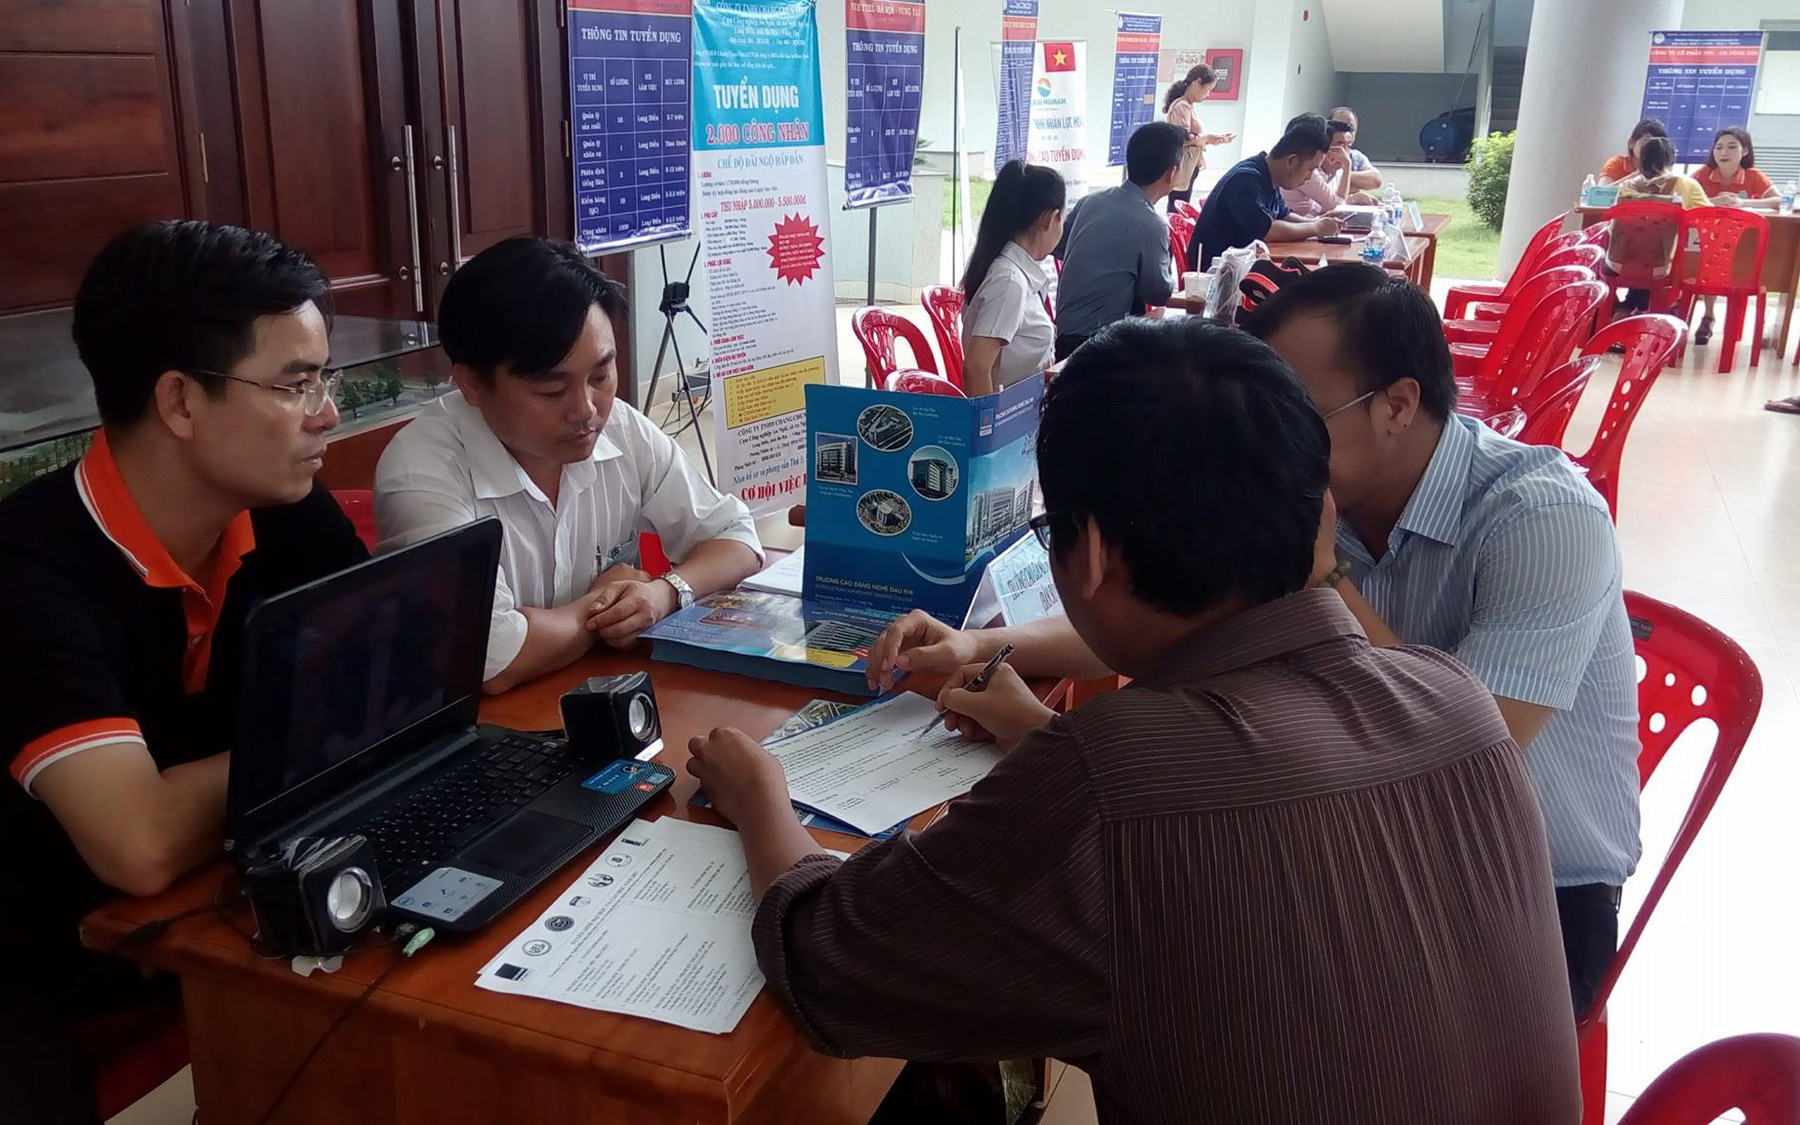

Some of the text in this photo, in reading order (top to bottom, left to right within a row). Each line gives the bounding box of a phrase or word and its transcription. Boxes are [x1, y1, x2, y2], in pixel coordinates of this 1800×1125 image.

[581, 25, 681, 45] THÔNG TIN TUYỂN DỤNG
[852, 41, 874, 53] THÔNG
[713, 75, 800, 114] TUYỂN DỤNG
[707, 117, 809, 145] 2.000 CÔNG NHÂN
[738, 428, 753, 437] CÔNG
[741, 484, 755, 501] CƠ
[757, 481, 775, 501] HỘI
[779, 475, 801, 494] VIỆC
